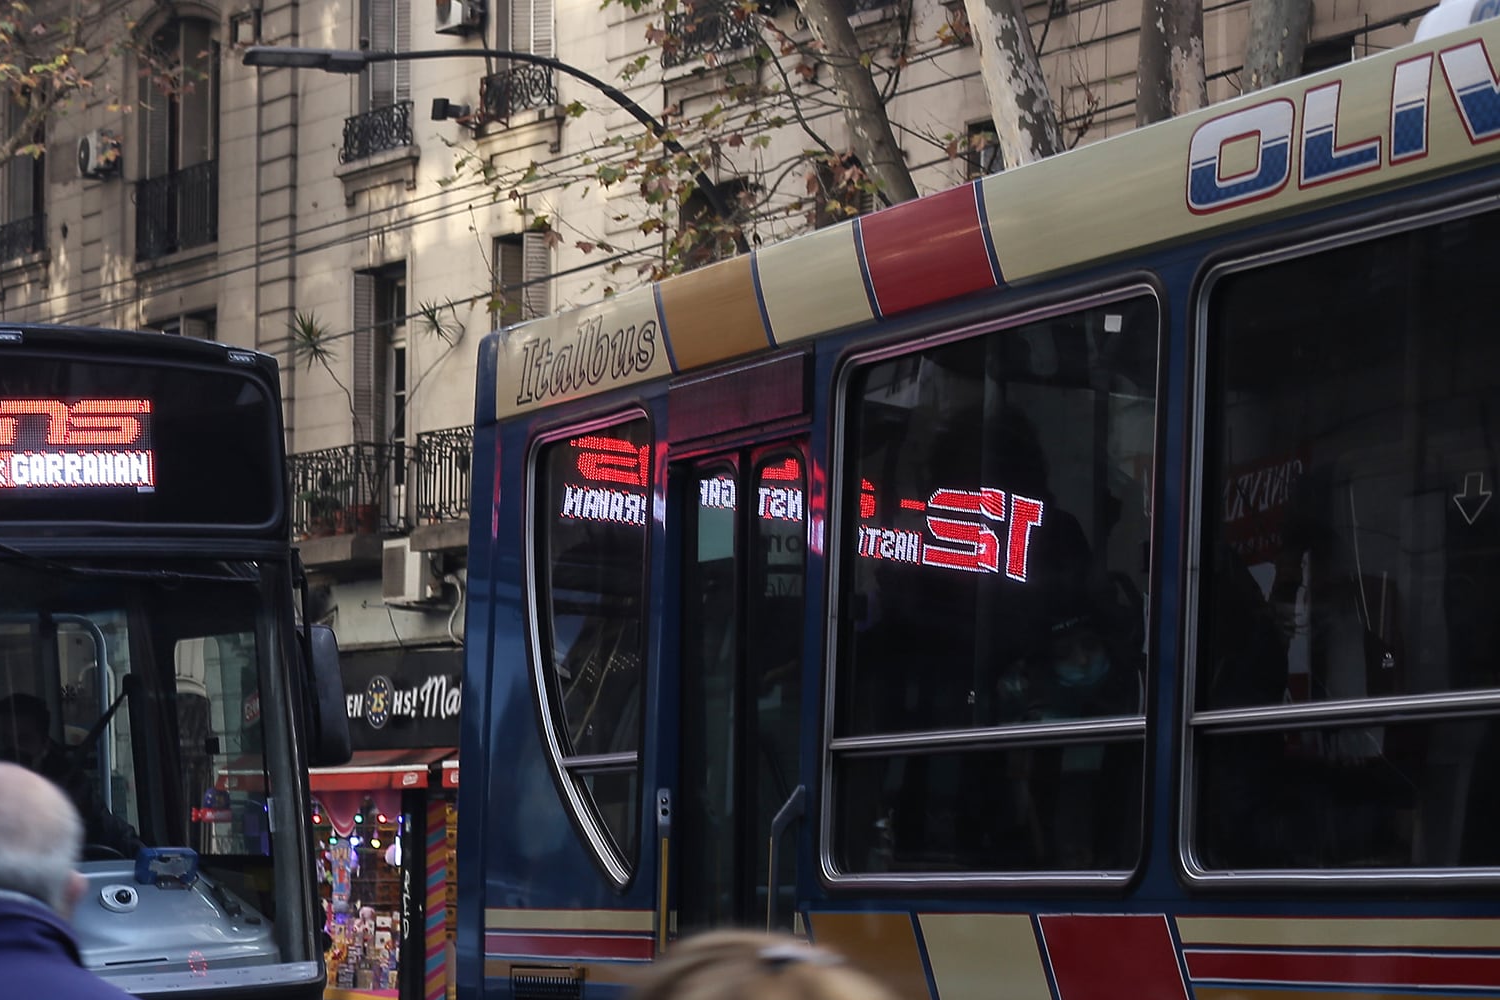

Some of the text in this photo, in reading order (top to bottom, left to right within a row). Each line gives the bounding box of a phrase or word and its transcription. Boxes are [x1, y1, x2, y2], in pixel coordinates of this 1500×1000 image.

[517, 316, 657, 405] Italbus
[12, 453, 148, 488] GARRAHAN
[393, 687, 418, 718] HS!
[420, 674, 462, 719] Ma
